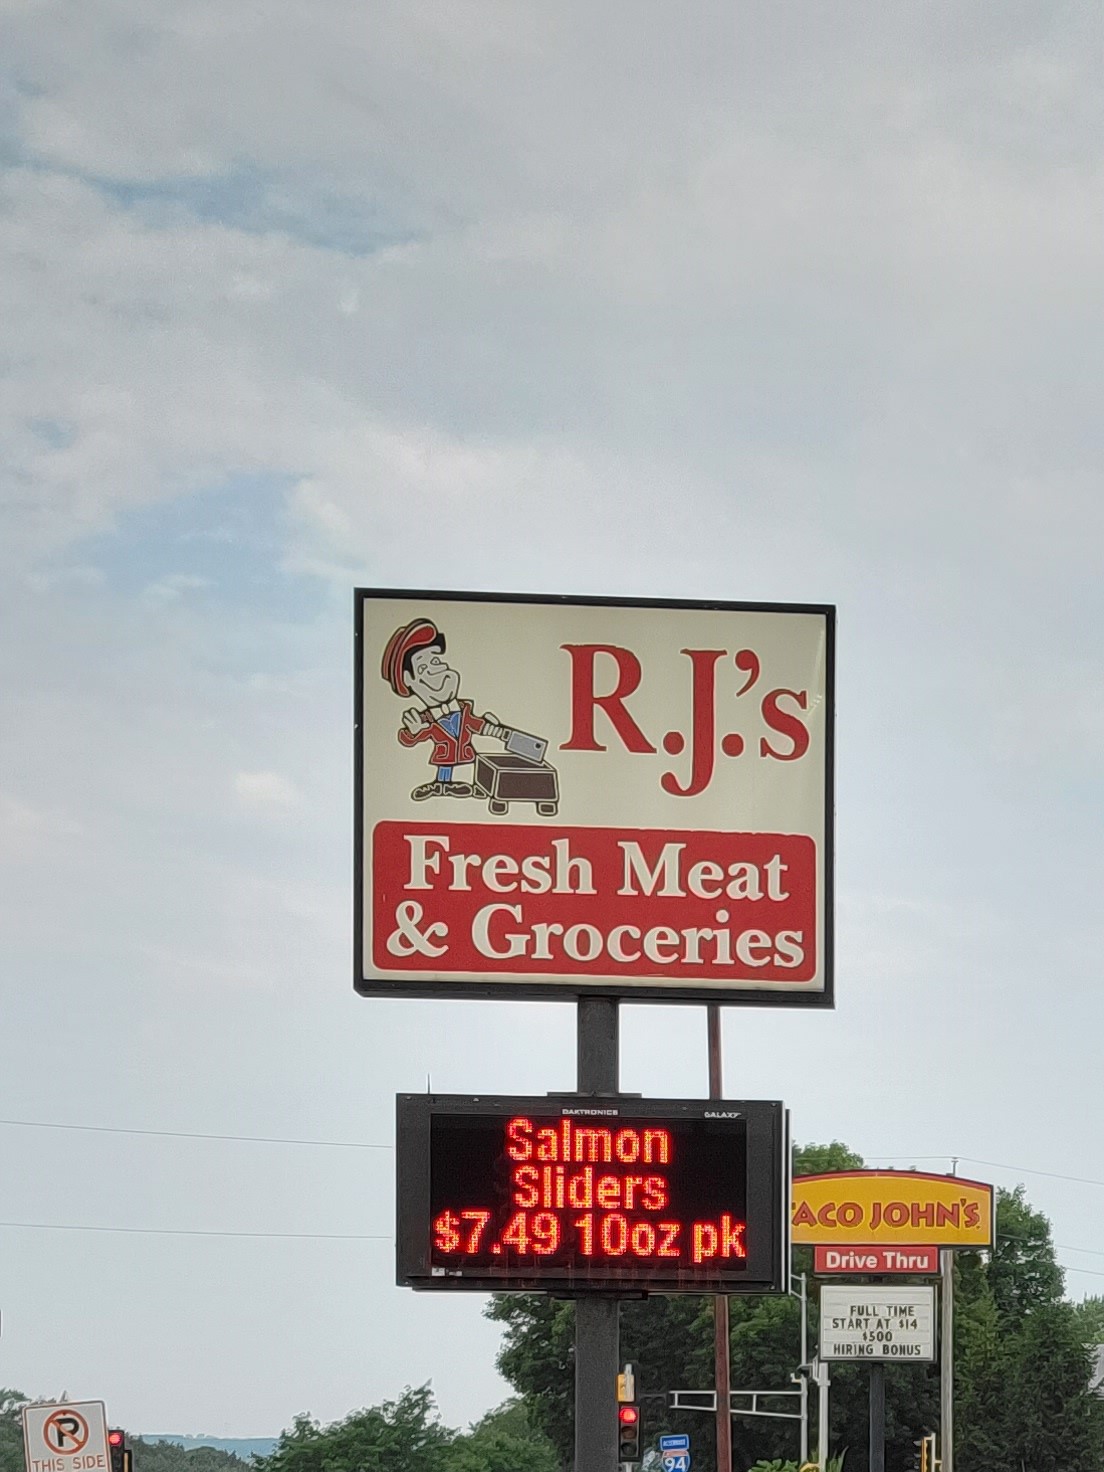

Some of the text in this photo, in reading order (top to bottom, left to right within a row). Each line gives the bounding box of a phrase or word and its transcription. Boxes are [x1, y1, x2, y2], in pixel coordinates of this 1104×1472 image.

[559, 643, 810, 797] R.J.'s
[403, 834, 790, 901] Fresh Meat
[386, 900, 805, 967] & Groceries
[562, 1108, 619, 1116] DAKTRONICS
[704, 1111, 742, 1119] GALAXY
[506, 1117, 670, 1163] Salmon
[514, 1165, 668, 1210] Sliders
[791, 1199, 981, 1230] ACO JOHN'S
[433, 1210, 747, 1263] $7.49 10oz pk
[826, 1251, 929, 1269] Drive Thru
[850, 1305, 915, 1317] FULL TIME
[832, 1317, 918, 1330] START AT $14
[862, 1331, 893, 1342] $500
[833, 1343, 922, 1356] HIRING BONUS
[71, 1454, 106, 1469] SIDE
[664, 1456, 687, 1472] 94
